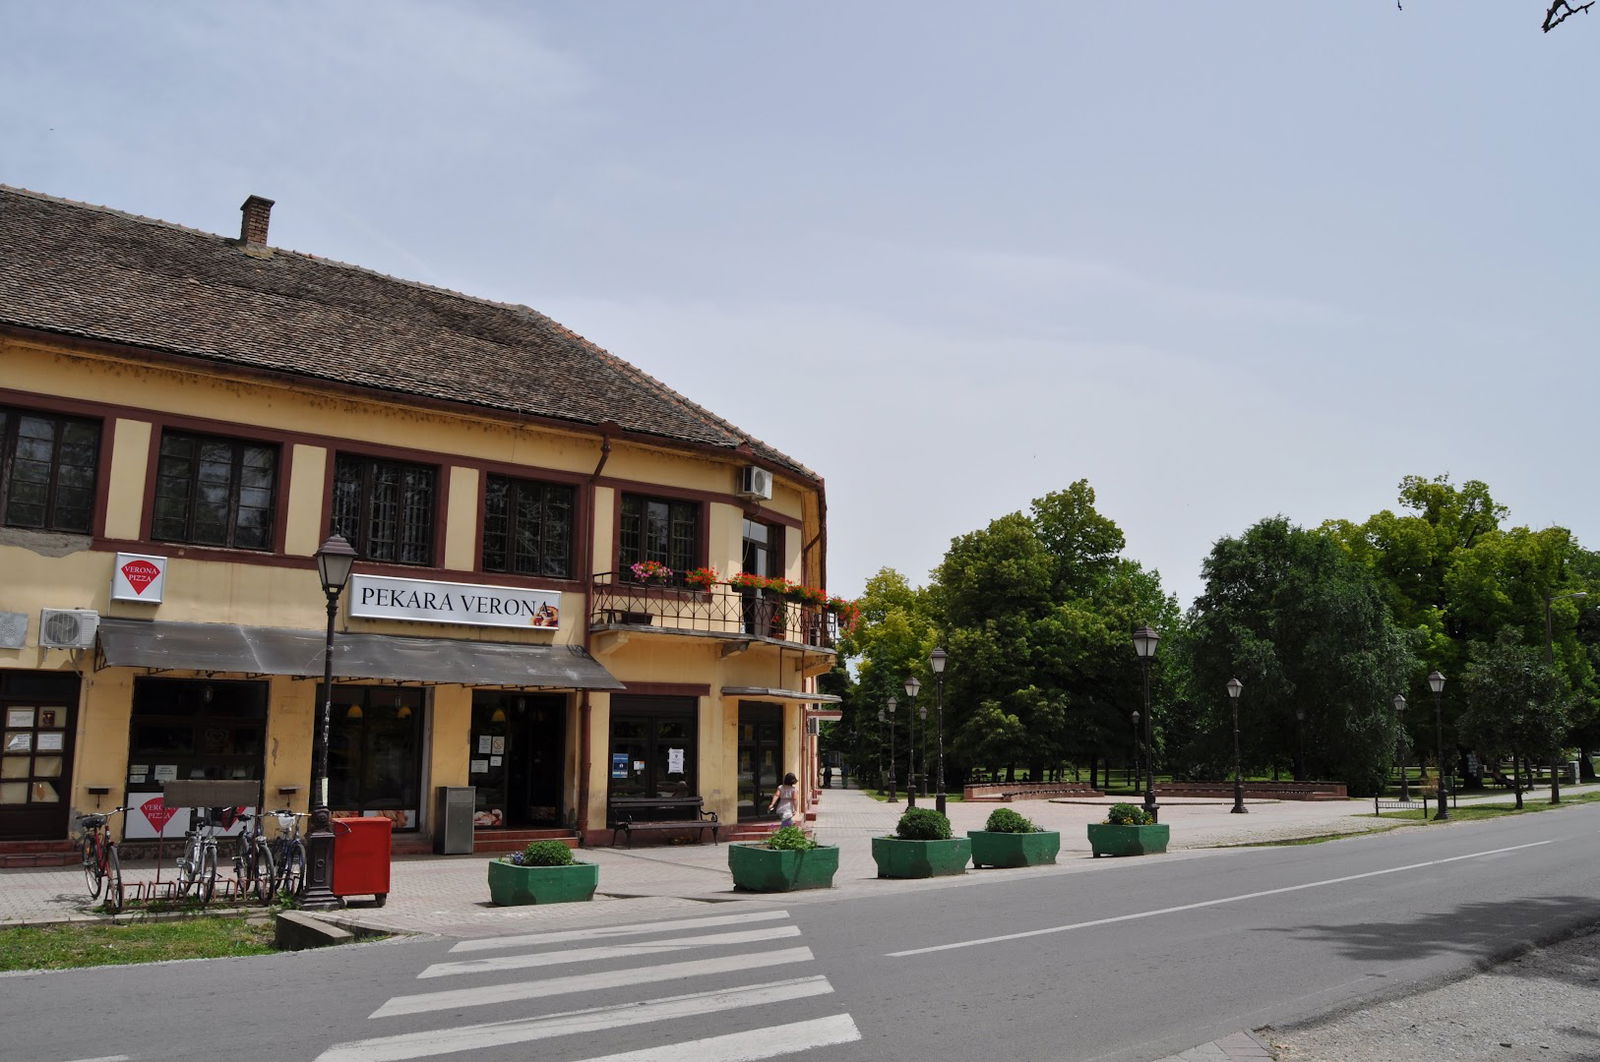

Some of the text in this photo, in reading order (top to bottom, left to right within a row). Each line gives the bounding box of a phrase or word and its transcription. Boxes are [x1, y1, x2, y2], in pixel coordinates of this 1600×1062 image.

[124, 566, 158, 575] VERONA
[128, 574, 153, 582] PIZZA
[361, 587, 549, 617] PEKARA VERONA
[147, 812, 171, 820] PIZZA
